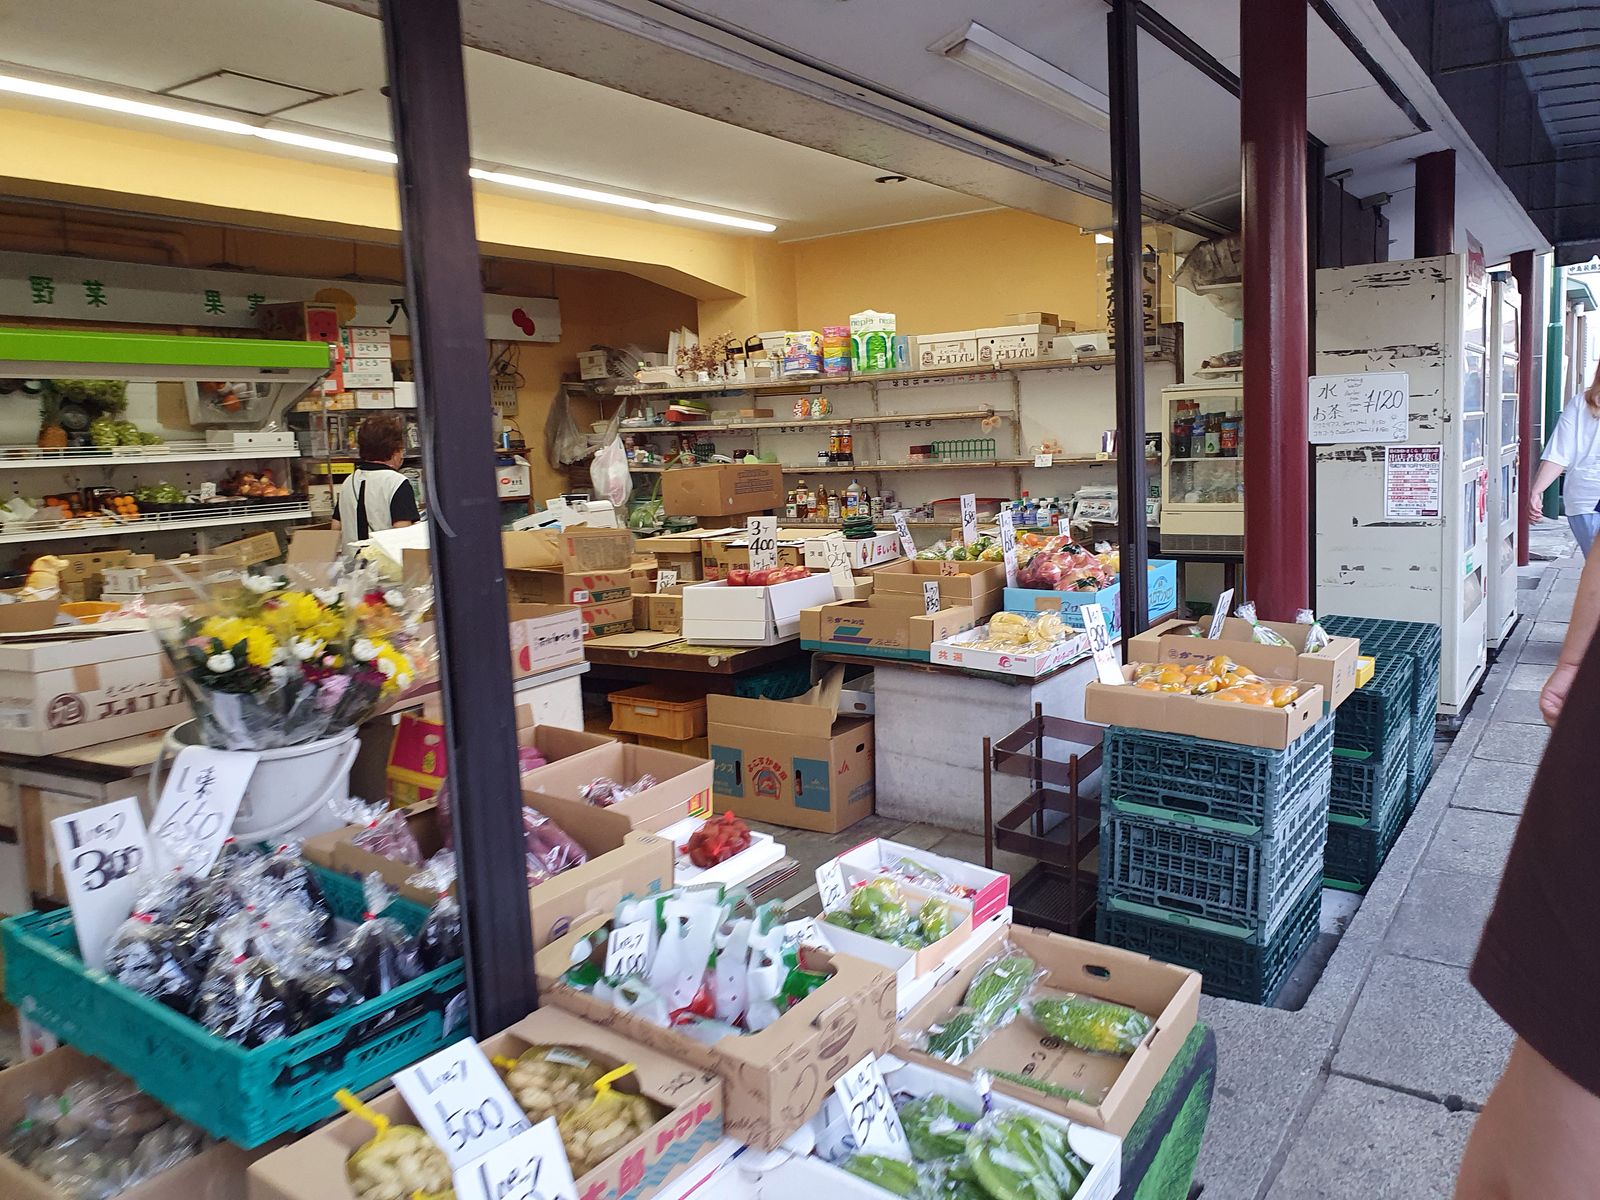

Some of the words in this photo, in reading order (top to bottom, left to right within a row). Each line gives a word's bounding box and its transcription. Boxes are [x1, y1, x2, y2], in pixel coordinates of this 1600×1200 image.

[29, 275, 108, 308] 野菜
[1318, 383, 1338, 400] 水
[1363, 389, 1404, 414] ¥120
[1312, 404, 1344, 422] お茶
[750, 536, 775, 556] 400
[434, 1097, 504, 1152] 500
